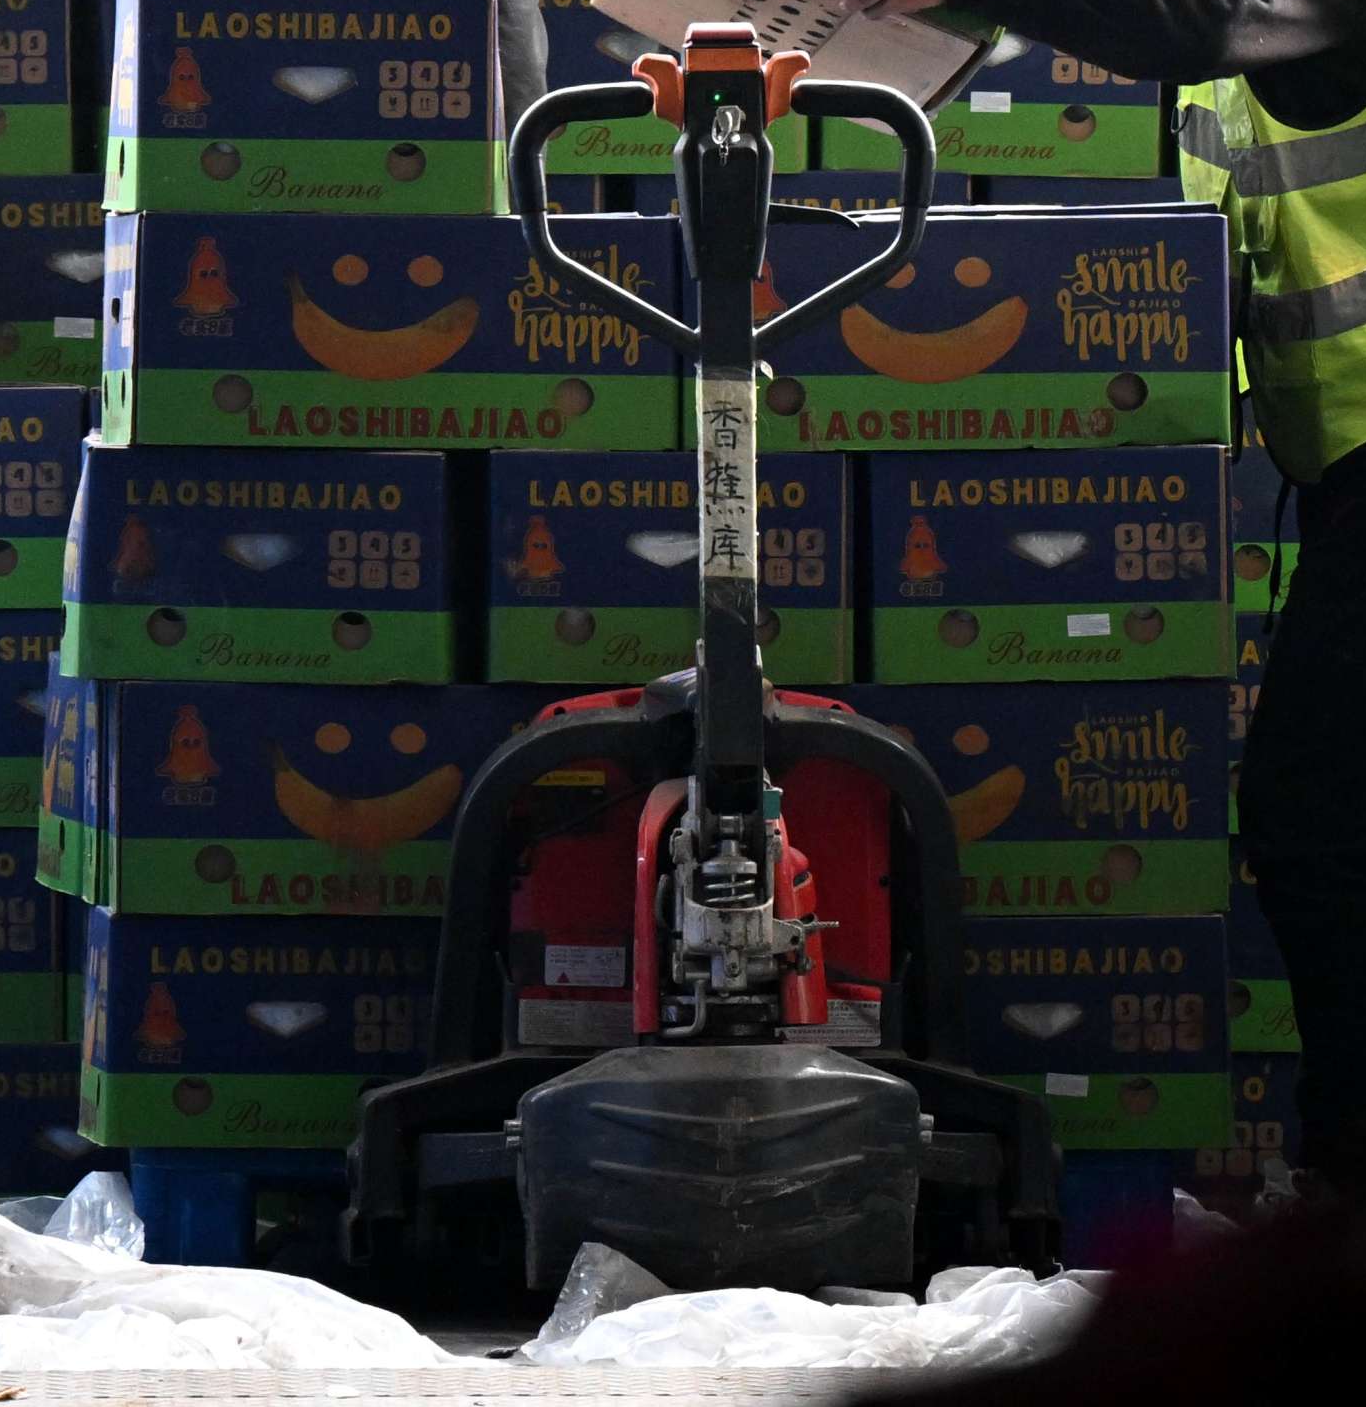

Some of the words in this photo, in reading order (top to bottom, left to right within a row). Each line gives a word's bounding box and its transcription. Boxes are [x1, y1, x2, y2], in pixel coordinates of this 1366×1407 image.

[176, 12, 452, 41] LAOSHIBAJIAO
[939, 127, 1056, 160] Banana
[249, 165, 384, 200] Banana
[1061, 241, 1203, 303] smile
[1129, 300, 1181, 308] BAJIAO
[508, 289, 651, 367] happy
[1057, 290, 1199, 362] happy
[248, 405, 564, 439] LAOSHIBAJIAO
[800, 408, 1116, 442] LAOSHIBAJIAO
[127, 479, 402, 510] LAOSHIBAJIAO
[910, 475, 1187, 506] LAOSHIBAJIAO
[196, 633, 332, 668] Banana
[988, 632, 1123, 666] Banana
